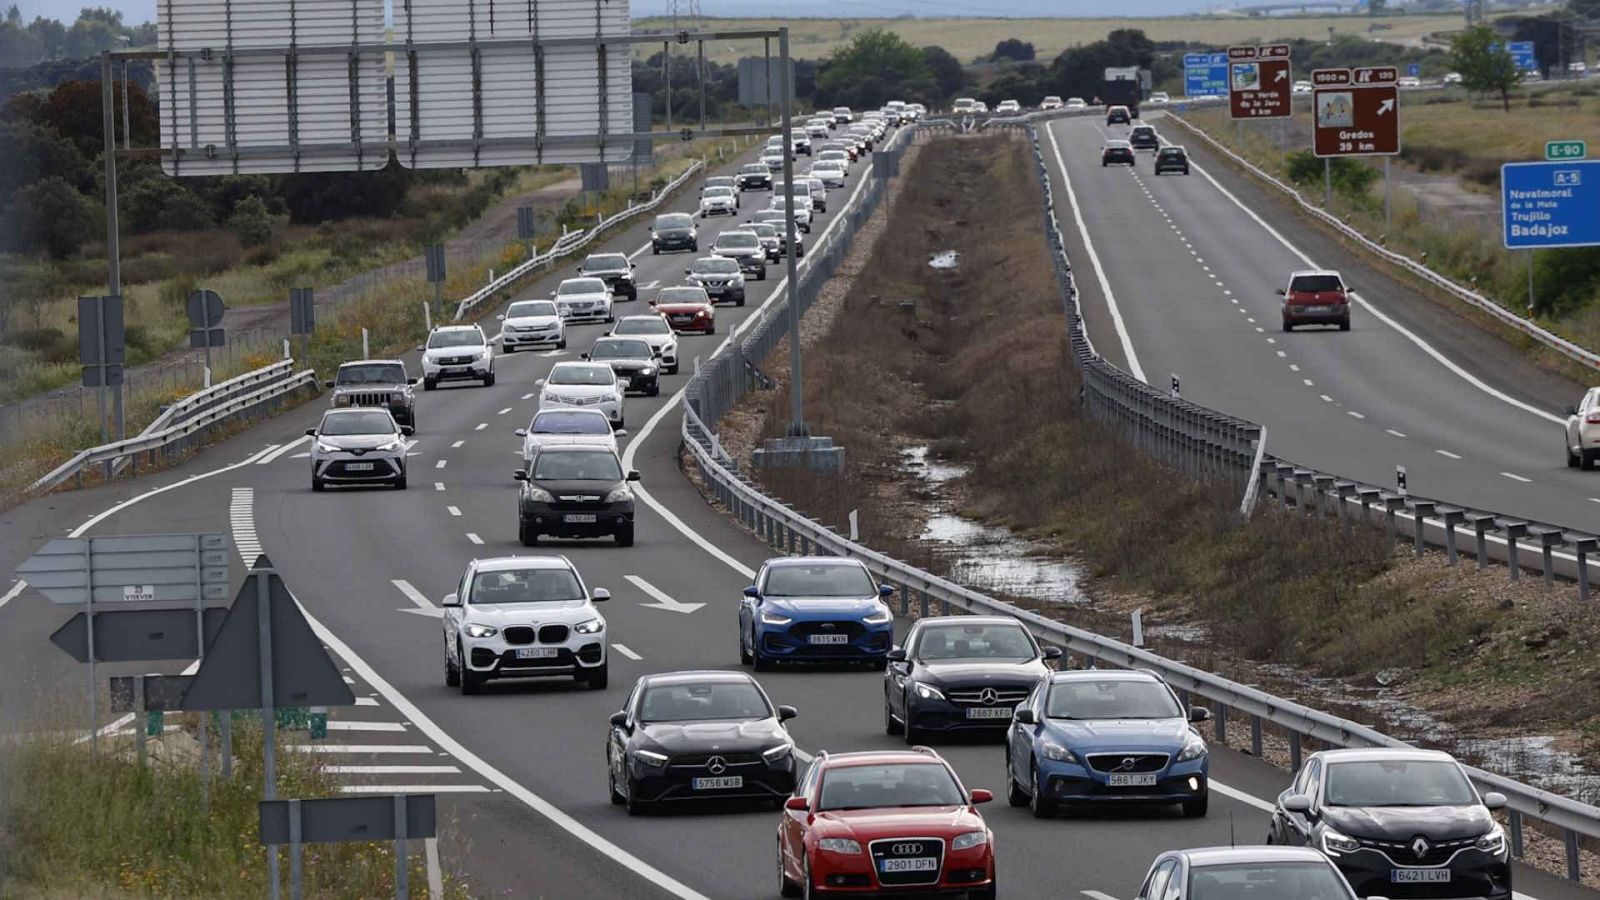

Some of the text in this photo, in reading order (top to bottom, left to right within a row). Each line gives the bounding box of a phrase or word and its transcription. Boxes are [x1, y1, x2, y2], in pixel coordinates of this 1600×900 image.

[1339, 131, 1375, 140] Gredos
[1339, 142, 1375, 151] 39 km
[1551, 144, 1580, 156] E-90
[1557, 173, 1578, 184] A-5
[1509, 188, 1573, 200] Navalmoral
[1511, 210, 1551, 222] Trujillo
[1510, 223, 1569, 237] Badajoz
[887, 859, 935, 870] 2901 DFN
[1398, 870, 1448, 881] 6421 LVH
